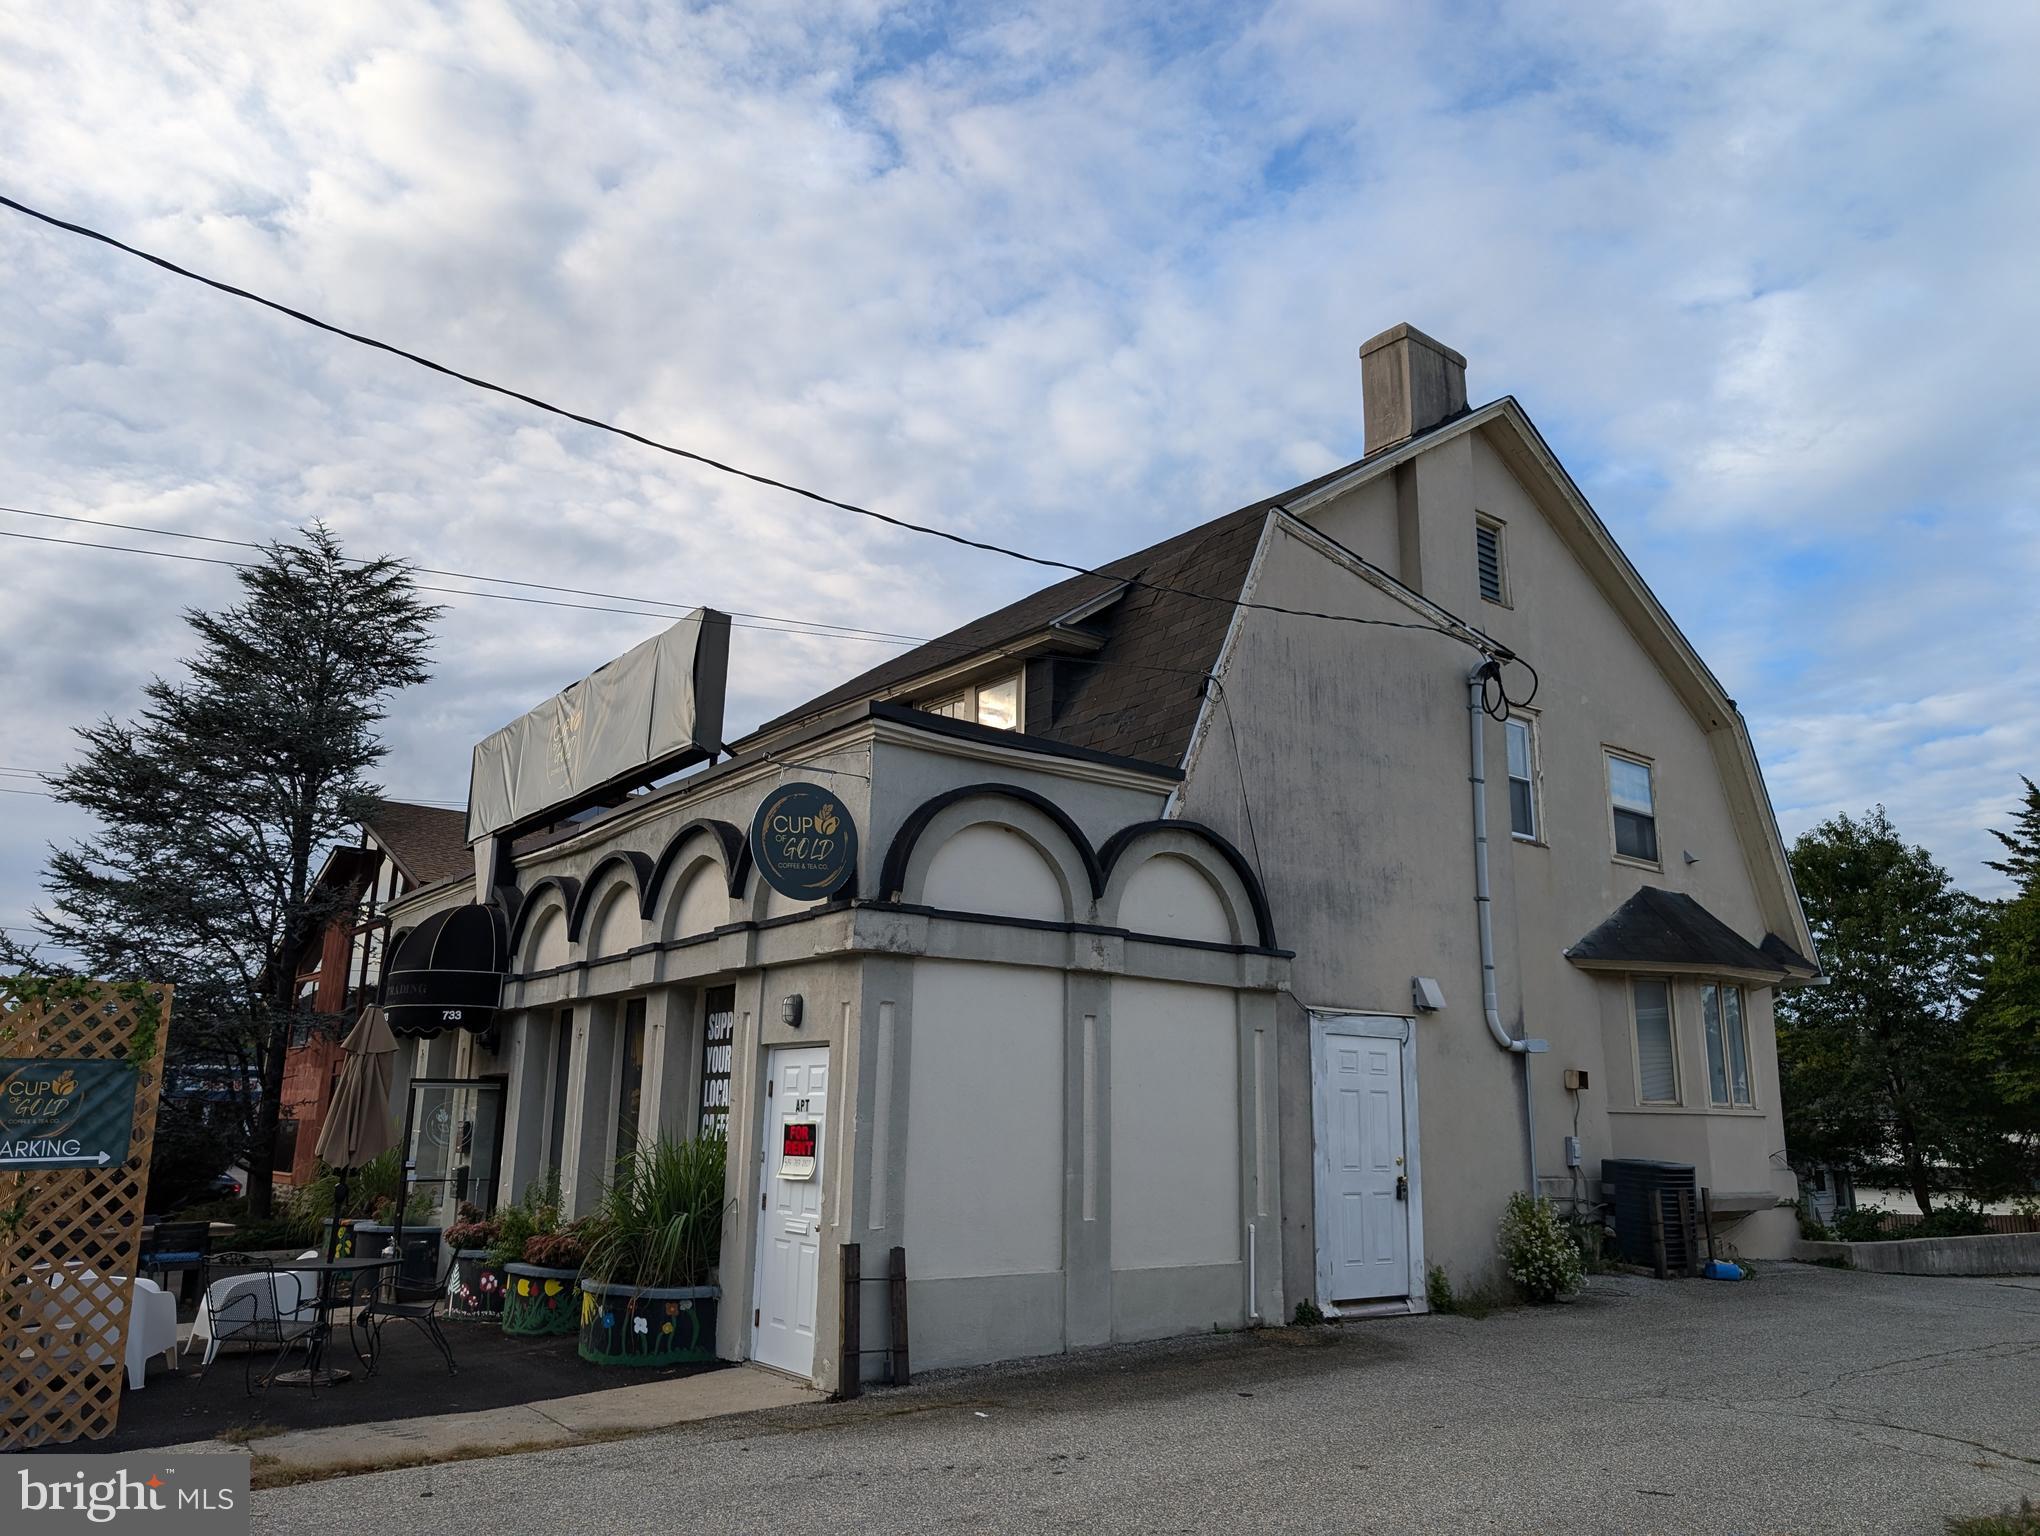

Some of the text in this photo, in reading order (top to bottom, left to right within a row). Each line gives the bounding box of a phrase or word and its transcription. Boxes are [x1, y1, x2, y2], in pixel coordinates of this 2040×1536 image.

[773, 815, 812, 834] CUP
[775, 834, 787, 842] OF
[783, 837, 835, 860] GOLD
[442, 1010, 462, 1021] 733
[706, 1045, 732, 1074] YOUR
[9, 1081, 51, 1096] CUP
[15, 1098, 70, 1117] GOLD
[795, 1099, 810, 1113] APT
[790, 1125, 809, 1140] FOR
[784, 1140, 814, 1156] RENT
